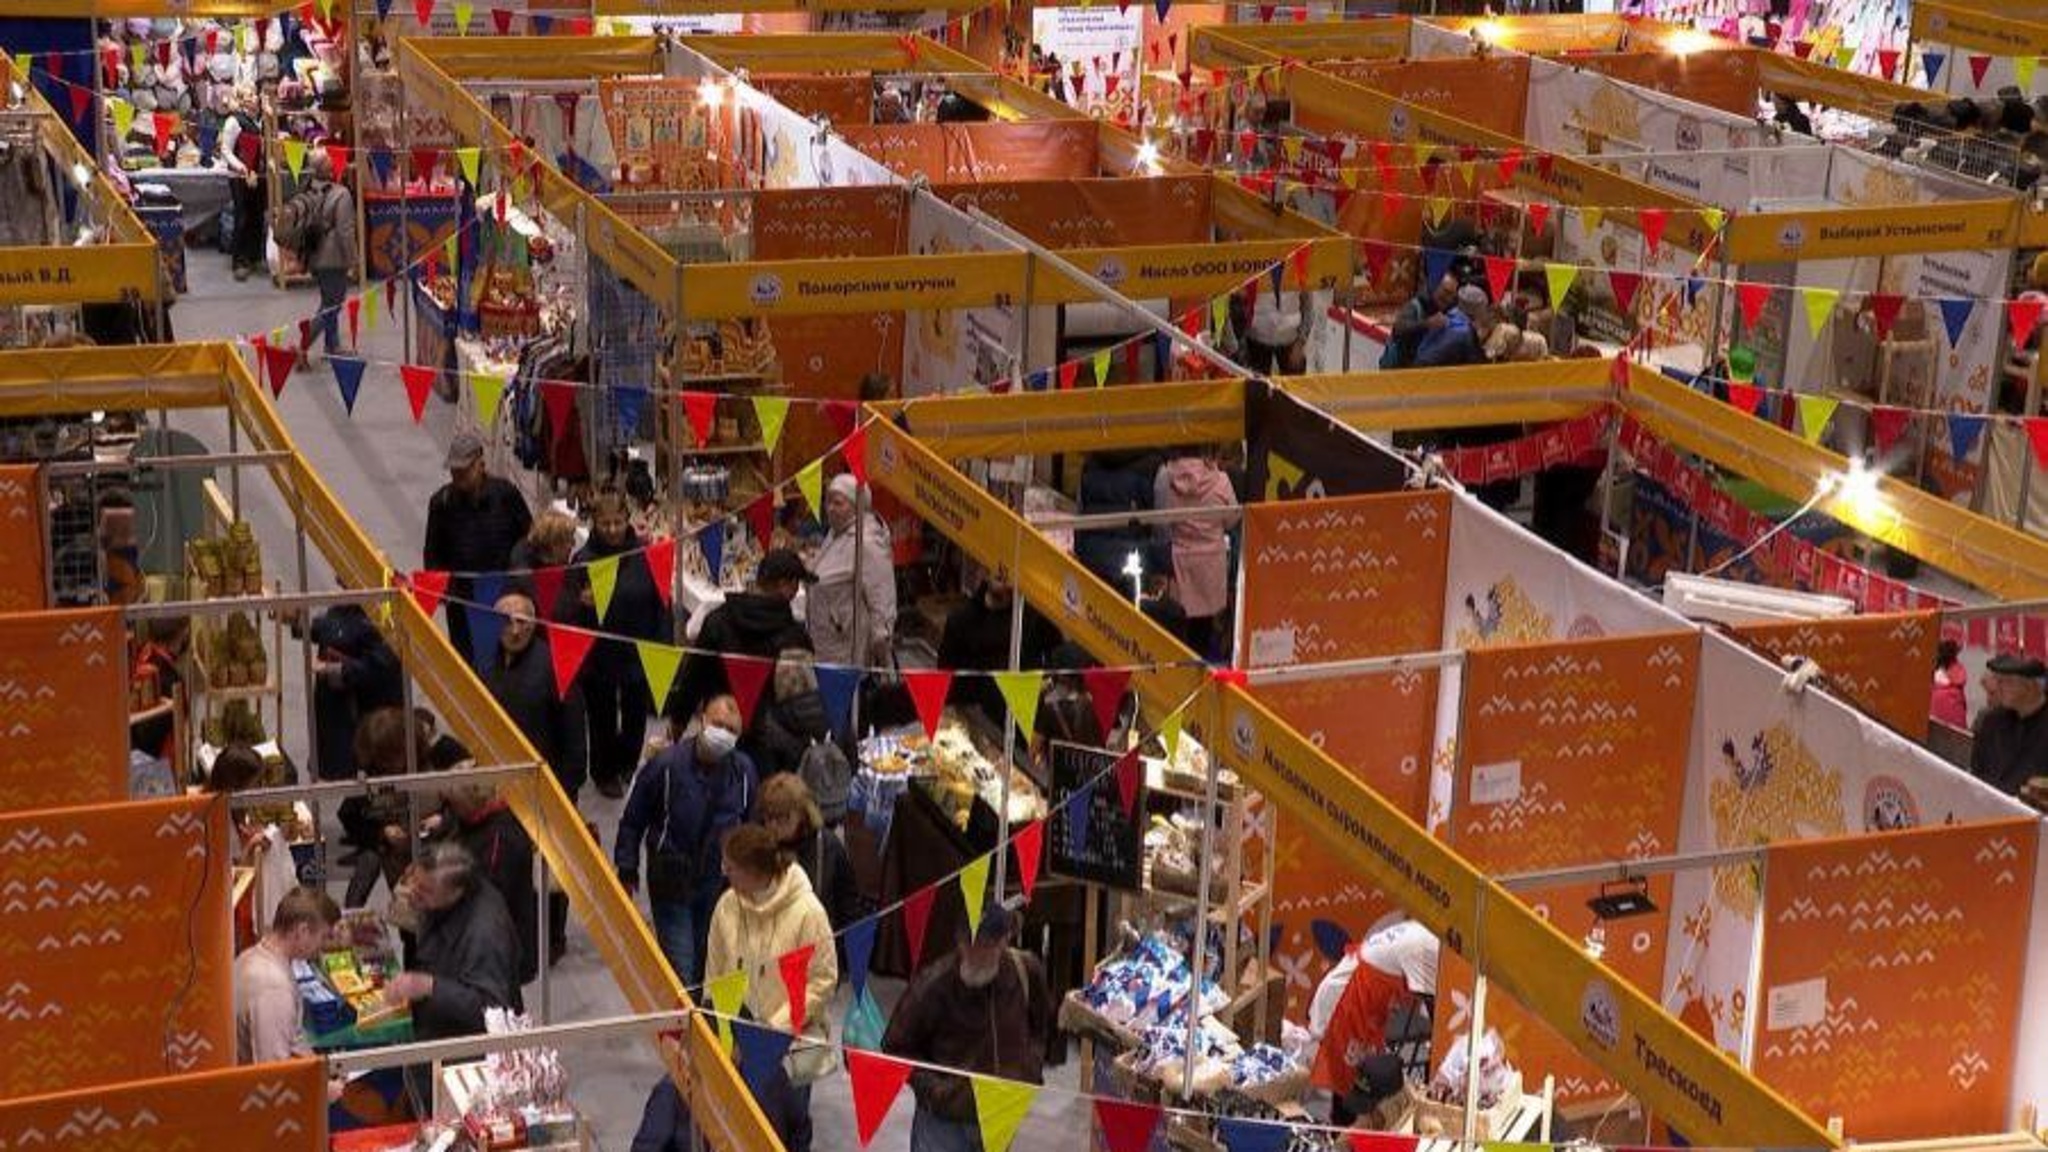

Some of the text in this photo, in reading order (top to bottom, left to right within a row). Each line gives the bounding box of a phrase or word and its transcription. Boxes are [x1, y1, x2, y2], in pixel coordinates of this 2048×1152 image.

[1192, 261, 1227, 275] ООО
[799, 276, 956, 296] Поморские штучки
[1634, 1030, 1722, 1126] Трескоед
